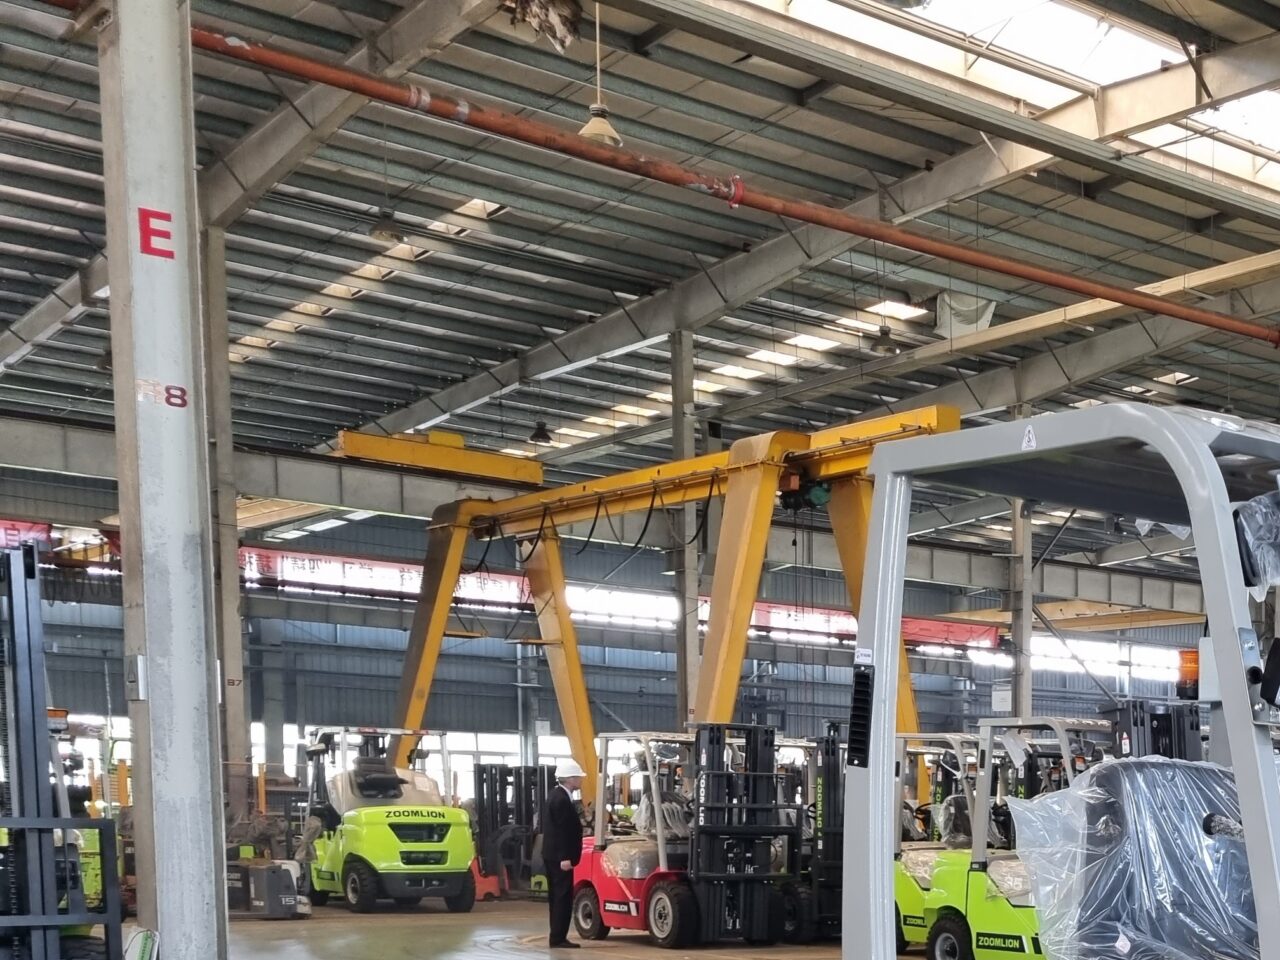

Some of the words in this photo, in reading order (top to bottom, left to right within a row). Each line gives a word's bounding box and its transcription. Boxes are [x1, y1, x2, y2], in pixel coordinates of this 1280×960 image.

[138, 207, 175, 259] E
[385, 810, 446, 819] ZOOMLION
[978, 936, 1020, 949] ZOOMLION
